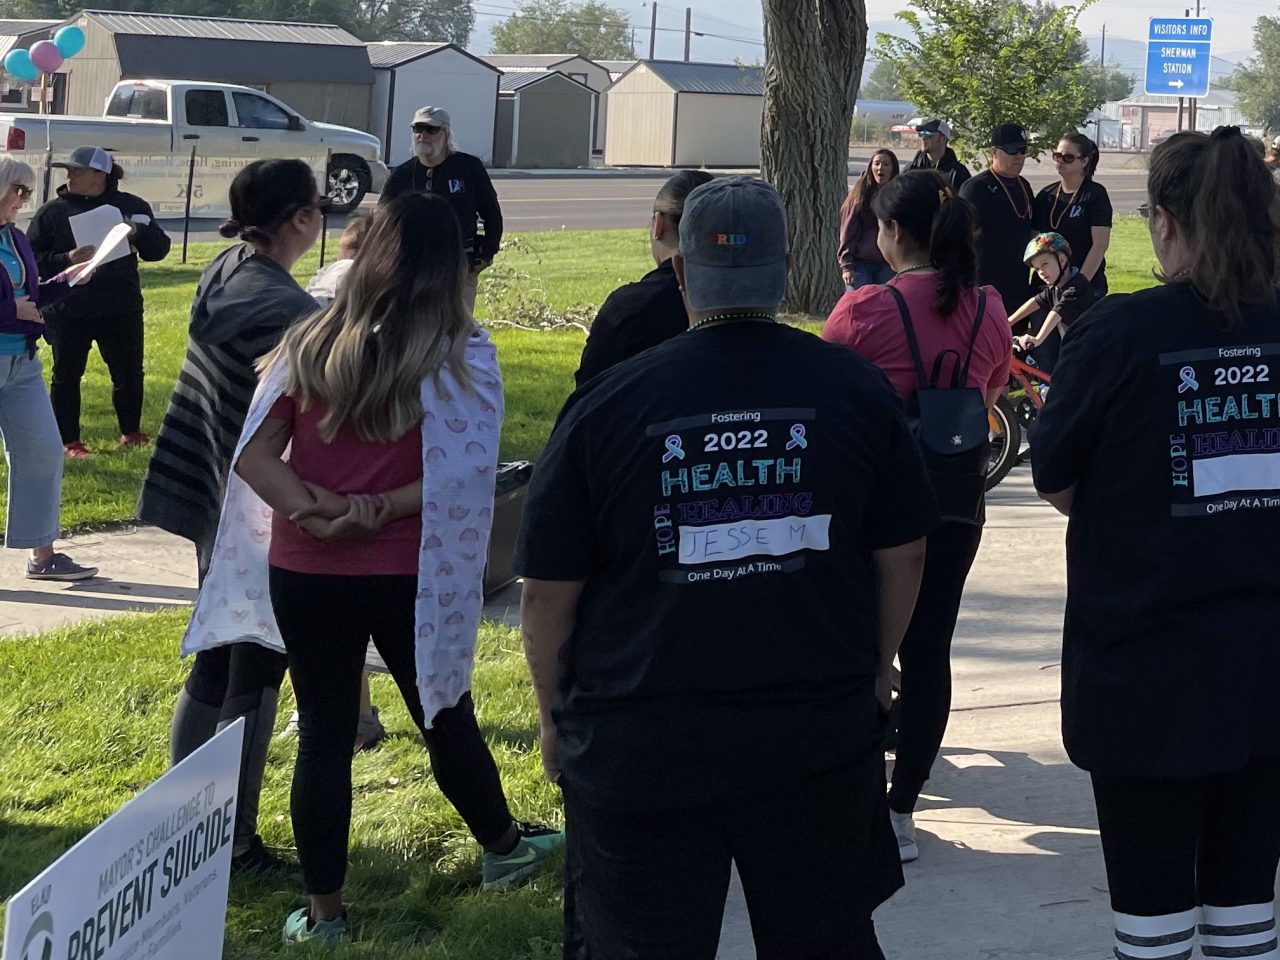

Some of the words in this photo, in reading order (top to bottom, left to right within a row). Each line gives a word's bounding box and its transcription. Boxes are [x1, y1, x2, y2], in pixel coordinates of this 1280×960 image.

[1154, 24, 1187, 35] VISITORS
[1190, 24, 1208, 36] INFO
[1161, 47, 1197, 59] SHERMAN
[1163, 63, 1192, 74] STATION
[1218, 346, 1261, 358] Fostering
[1214, 364, 1270, 386] 2022
[711, 411, 761, 423] Fostering
[703, 429, 768, 452] 2022
[1169, 433, 1188, 487] HOPE
[661, 457, 801, 497] HEALTH
[678, 492, 814, 523] HEALING
[1206, 503, 1223, 514] One
[1224, 499, 1238, 511] Day
[1239, 497, 1250, 508] At
[1253, 497, 1261, 507] A
[654, 503, 676, 556] HOPE
[685, 526, 771, 558] JESSE
[789, 523, 806, 543] M
[687, 569, 710, 582] One
[713, 568, 735, 580] Day
[747, 564, 755, 573] A
[756, 561, 782, 572] Time
[97, 837, 145, 900] MAYOR'S
[146, 790, 201, 857] CHALLENGE
[204, 781, 216, 807] TO
[67, 859, 158, 960] PREVENT
[160, 796, 234, 898] SUICIDE
